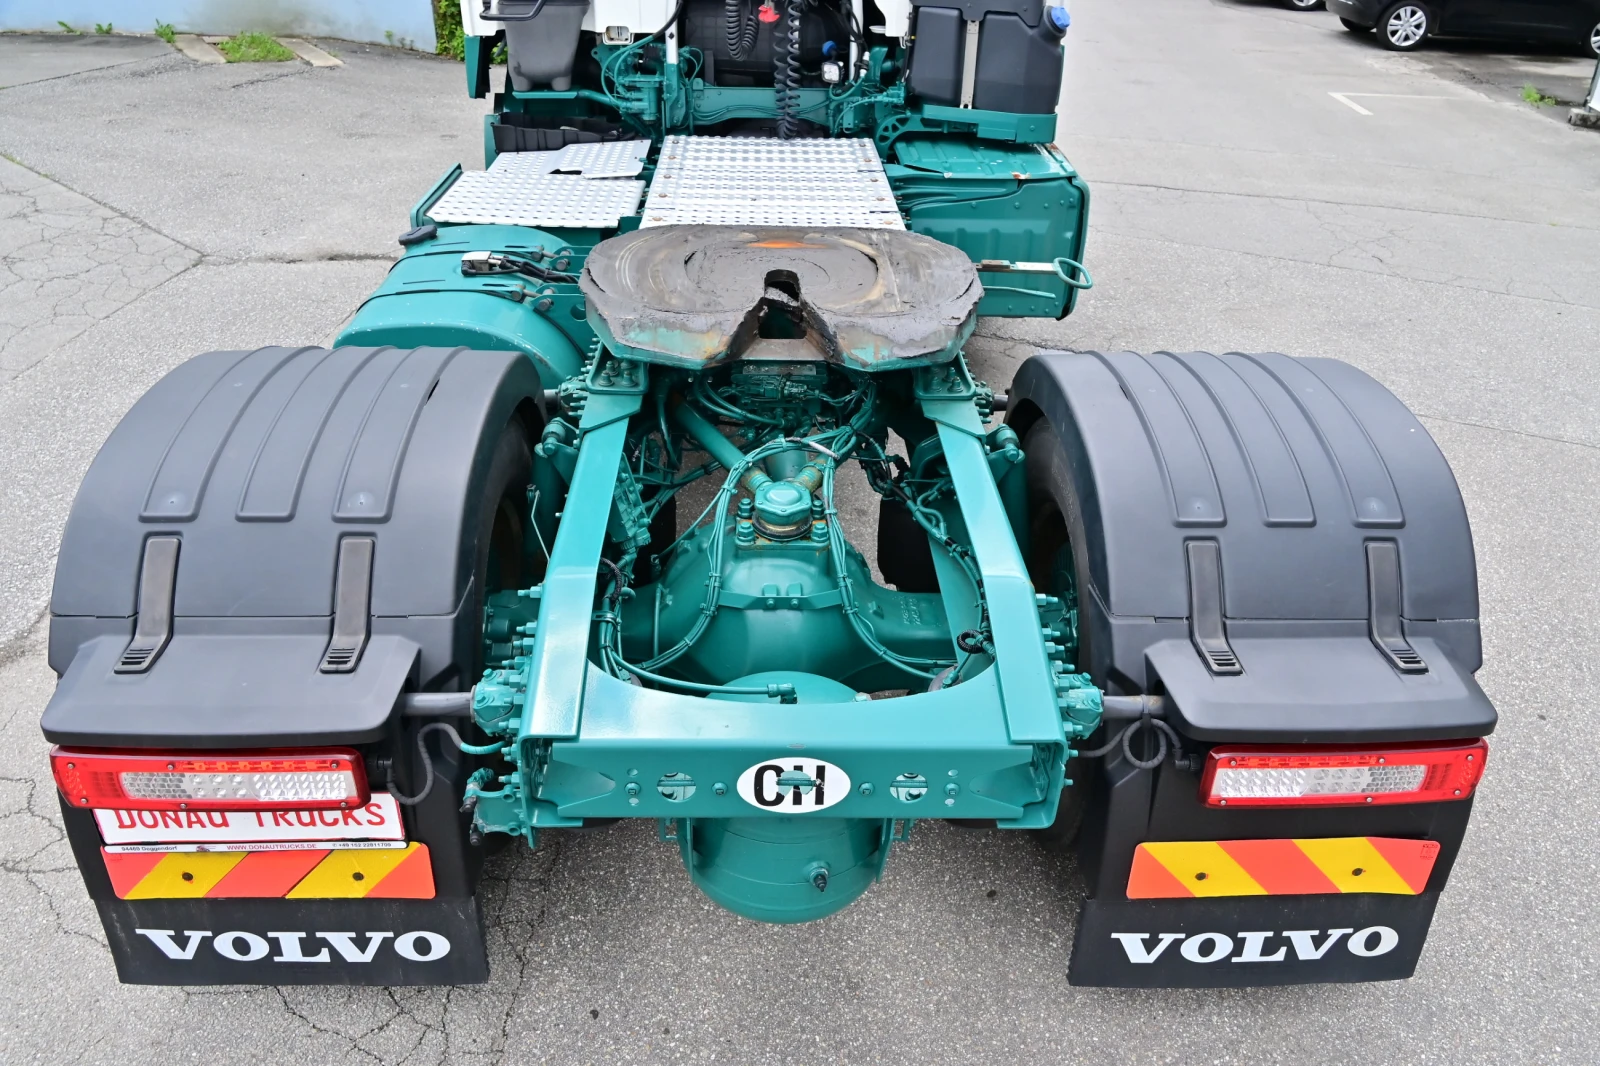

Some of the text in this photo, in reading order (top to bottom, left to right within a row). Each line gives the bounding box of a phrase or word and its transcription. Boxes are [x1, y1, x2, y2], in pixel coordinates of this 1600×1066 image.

[754, 764, 826, 807] CH
[113, 803, 386, 829] DONAU TRUCKS
[226, 843, 317, 851] WWW.DONAUTRUCKS.DE
[135, 928, 451, 963] VOLVO
[1110, 925, 1399, 964] VOLVO
